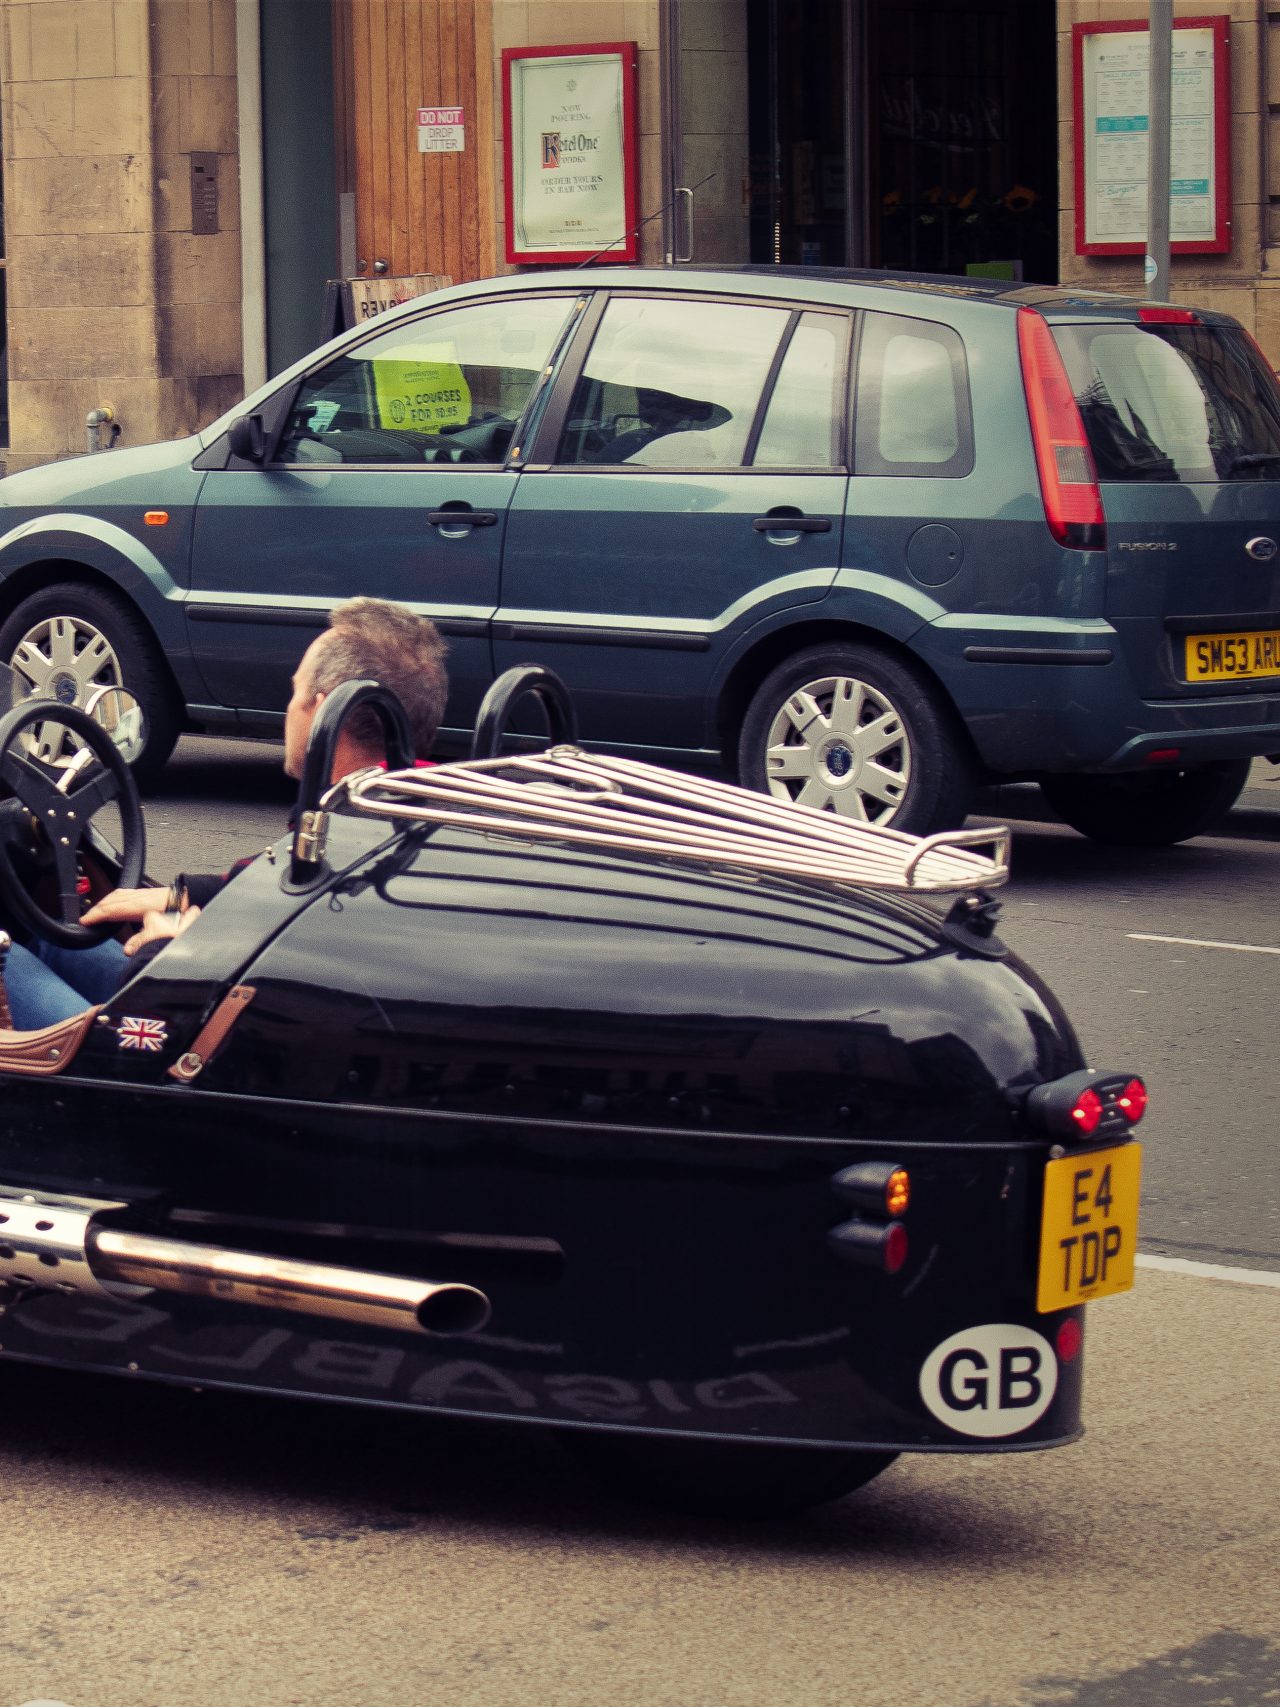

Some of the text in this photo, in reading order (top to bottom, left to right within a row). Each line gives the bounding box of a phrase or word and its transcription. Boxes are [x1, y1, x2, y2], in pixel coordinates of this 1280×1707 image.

[420, 110, 461, 125] DO NOT
[428, 127, 454, 138] DROP
[424, 138, 458, 150] LITTER
[578, 134, 599, 152] One
[573, 174, 604, 184] YOURS
[578, 182, 599, 193] NOW
[415, 389, 462, 405] COURSES
[410, 408, 431, 422] FOR
[1117, 542, 1168, 551] FUSION
[1196, 638, 1249, 674] SM53
[1071, 1164, 1113, 1226] E4
[1058, 1225, 1122, 1293] TDP
[938, 1346, 1043, 1412] GB
